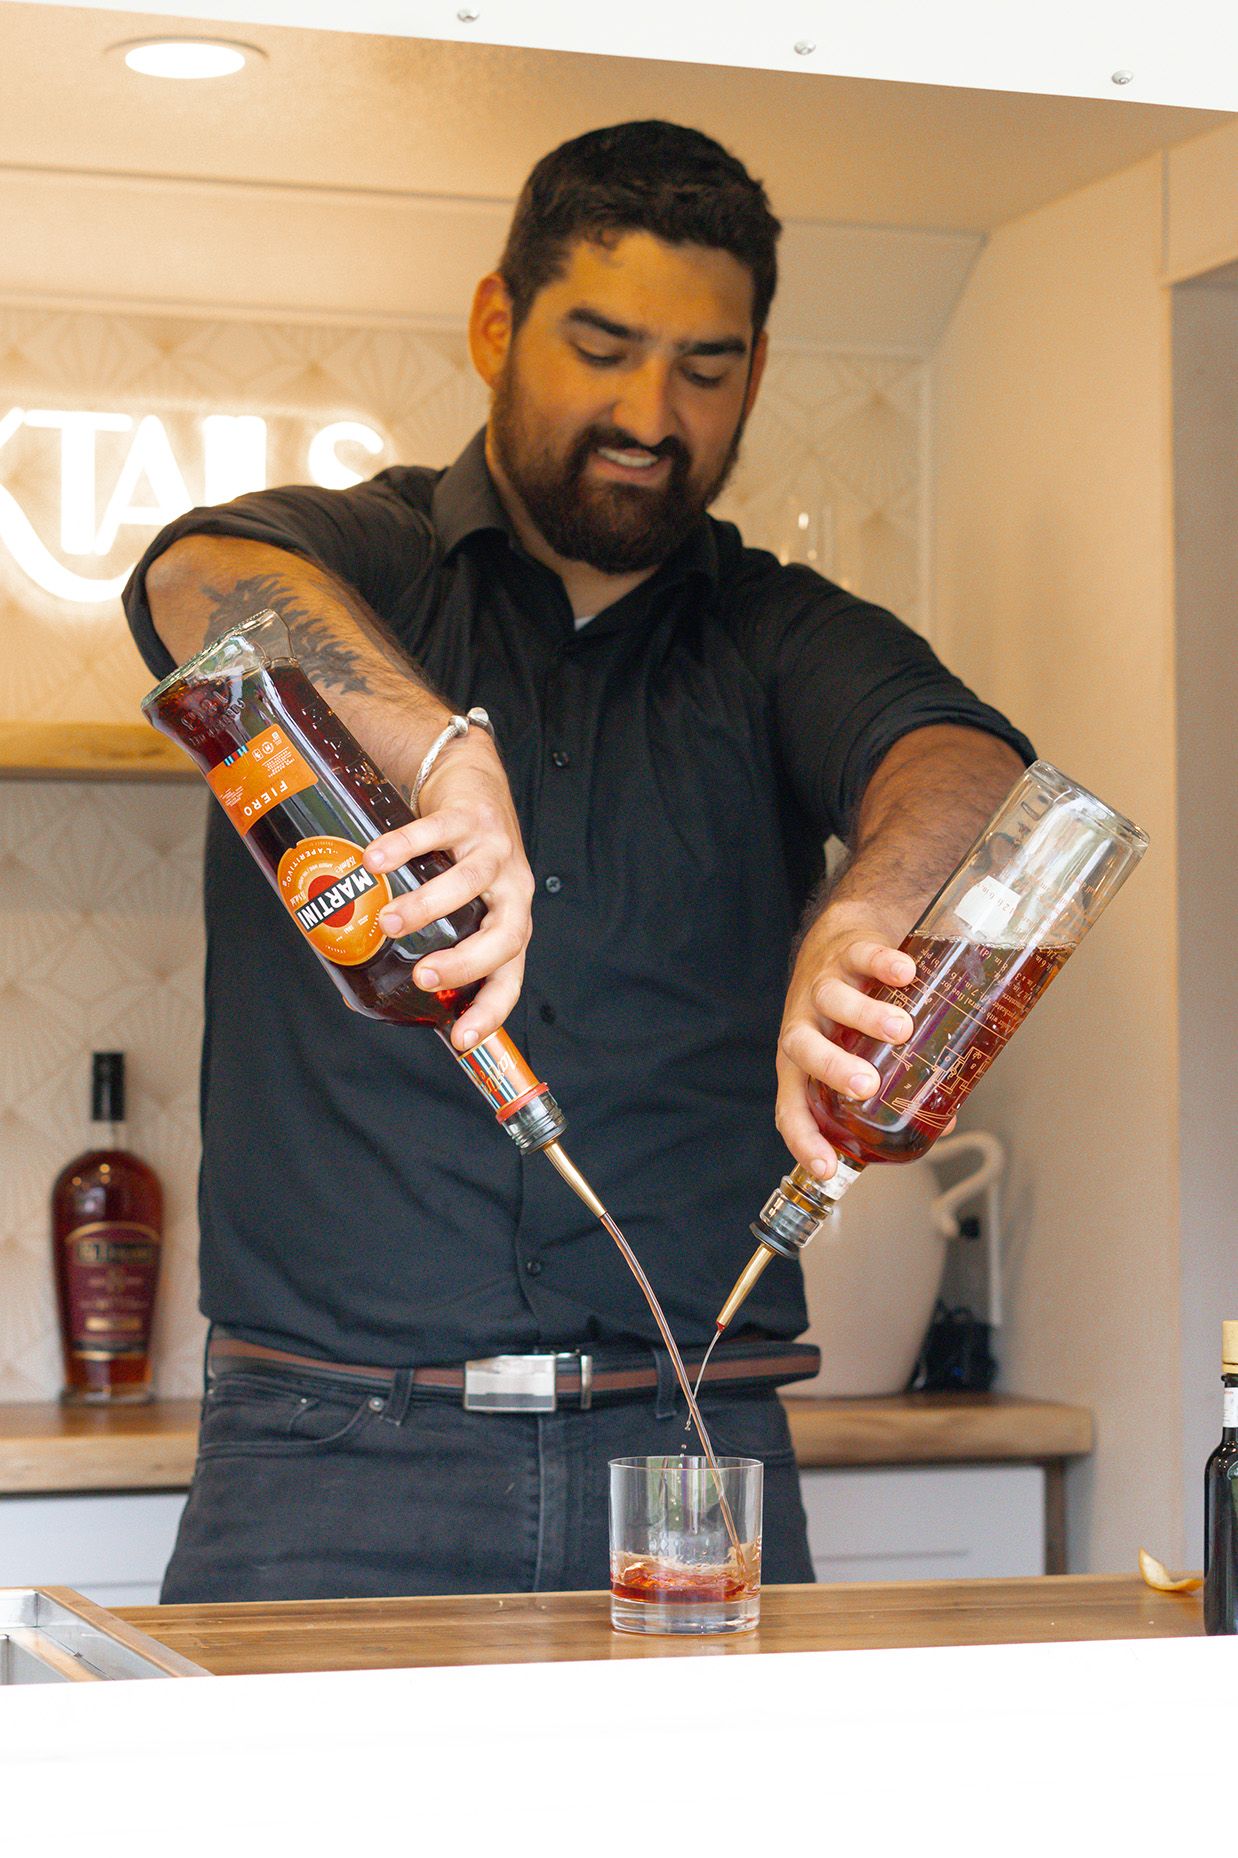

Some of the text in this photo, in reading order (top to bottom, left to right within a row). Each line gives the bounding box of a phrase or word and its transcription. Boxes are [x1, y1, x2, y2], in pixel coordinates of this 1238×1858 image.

[243, 780, 288, 816] FIERO
[296, 868, 374, 930] MARTINI
[978, 947, 992, 960] (d)
[930, 957, 942, 969] (b)
[949, 972, 957, 980] 6
[939, 980, 951, 991] for
[962, 980, 972, 990] in.
[949, 987, 964, 1001] flue
[970, 987, 978, 996] 7
[963, 997, 986, 1015] central
[985, 1011, 998, 1023] with
